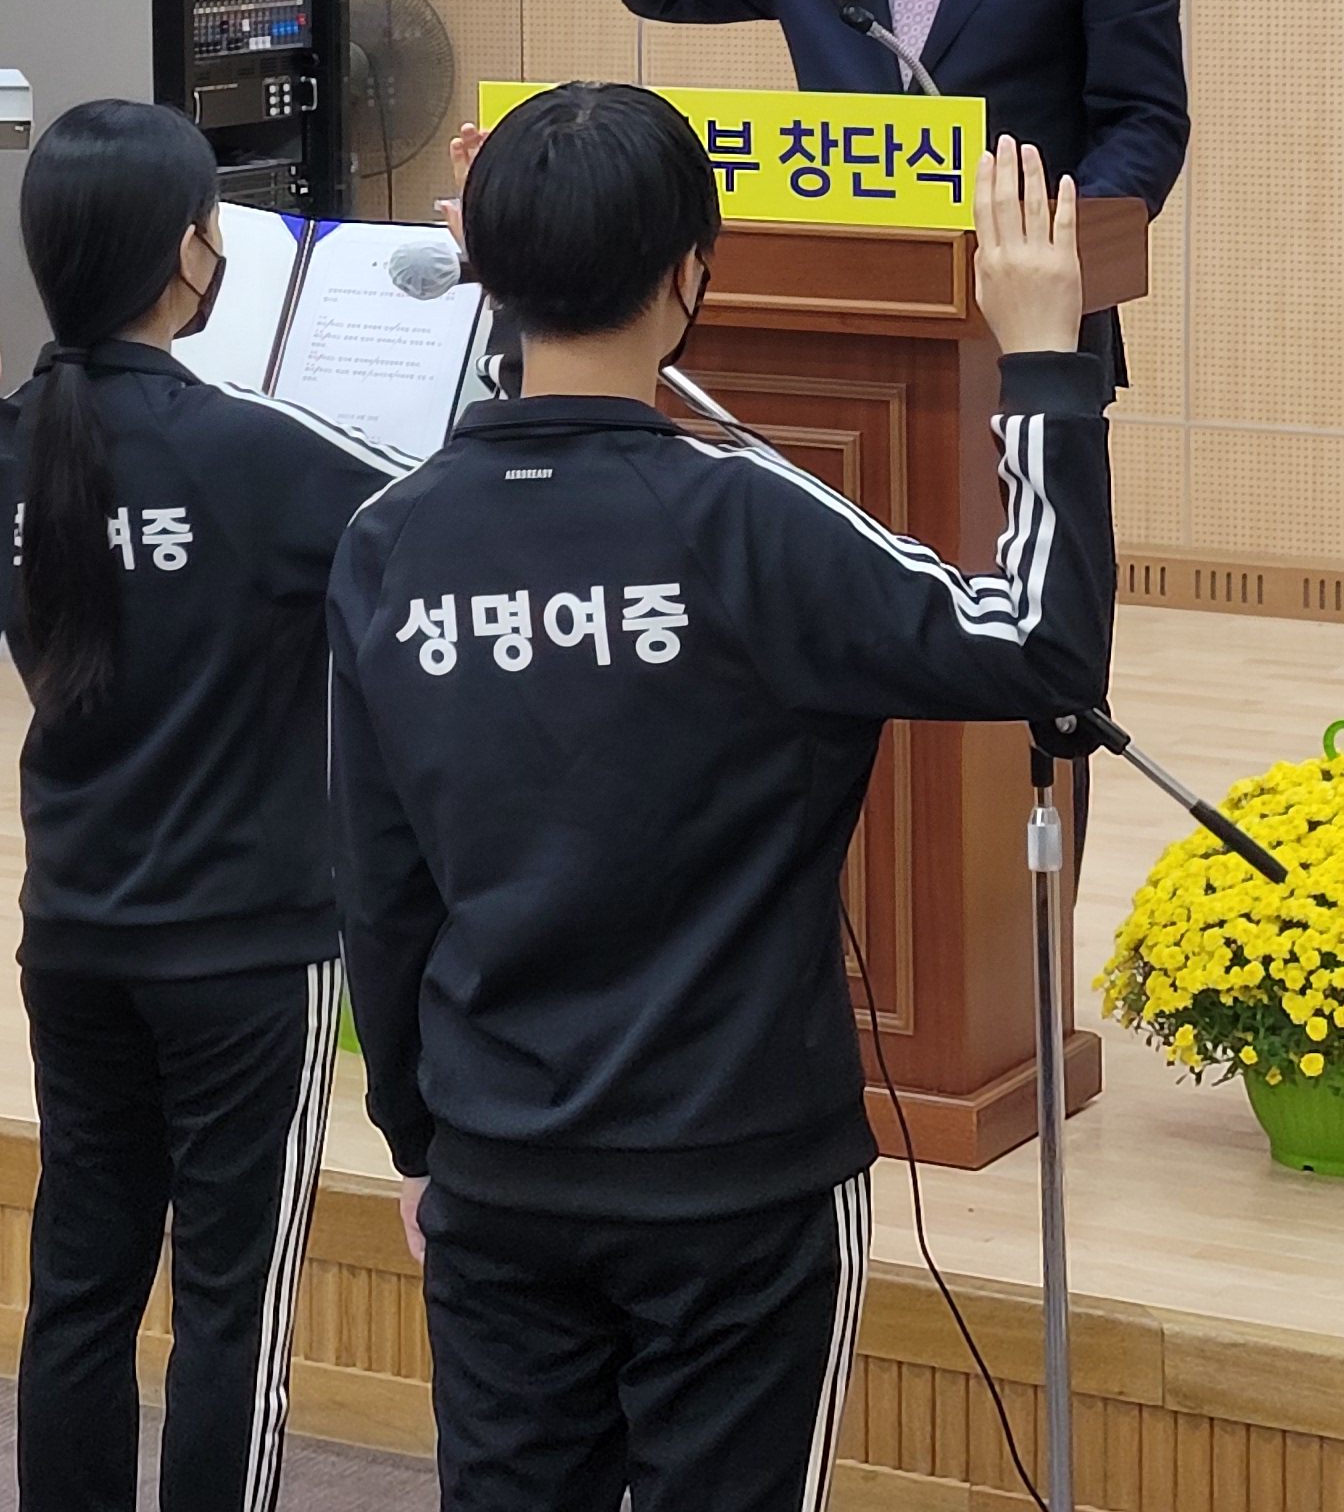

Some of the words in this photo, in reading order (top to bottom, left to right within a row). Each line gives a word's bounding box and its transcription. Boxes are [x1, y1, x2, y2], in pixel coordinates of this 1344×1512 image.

[706, 119, 761, 193] 부
[778, 119, 963, 205] 창단식
[394, 581, 690, 677] 성명여중
